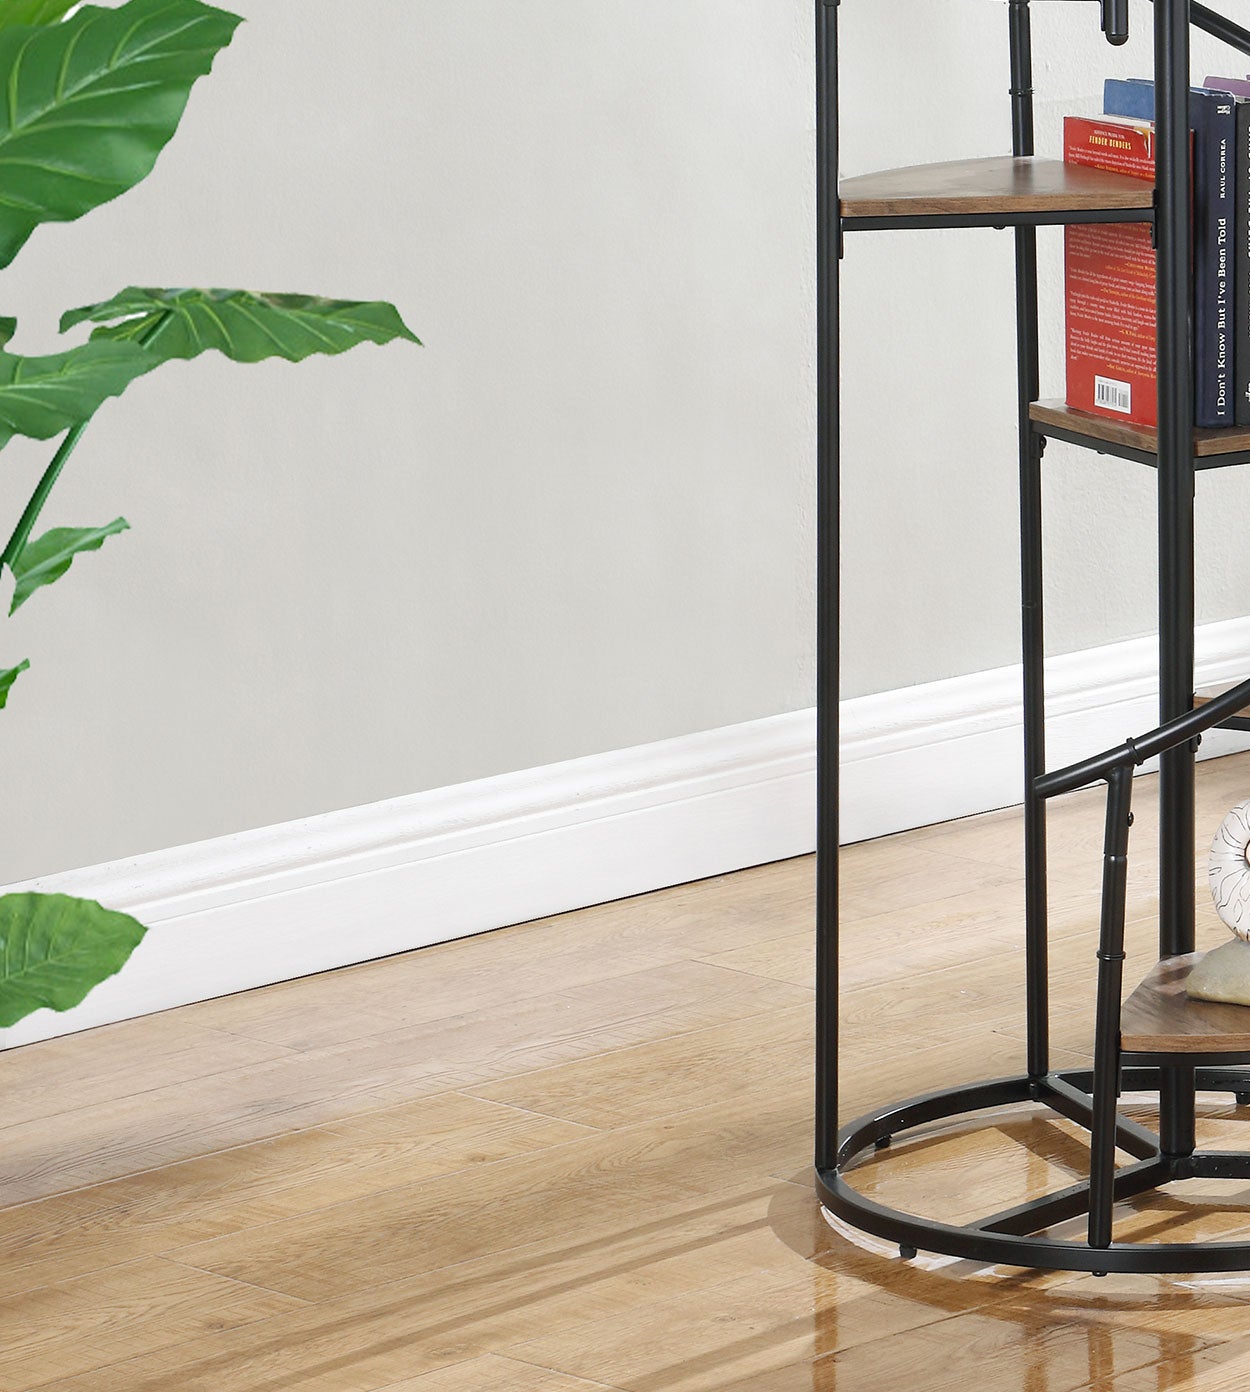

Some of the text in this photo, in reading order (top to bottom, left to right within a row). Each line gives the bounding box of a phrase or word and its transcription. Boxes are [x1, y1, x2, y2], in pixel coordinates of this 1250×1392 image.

[1089, 135, 1132, 150] FENDER BENDERS
[1217, 218, 1226, 245] Told
[1217, 248, 1226, 277] Been
[1217, 281, 1226, 304] I've
[1217, 308, 1226, 329] But
[1217, 333, 1226, 368] Know
[1217, 373, 1226, 406] Don't
